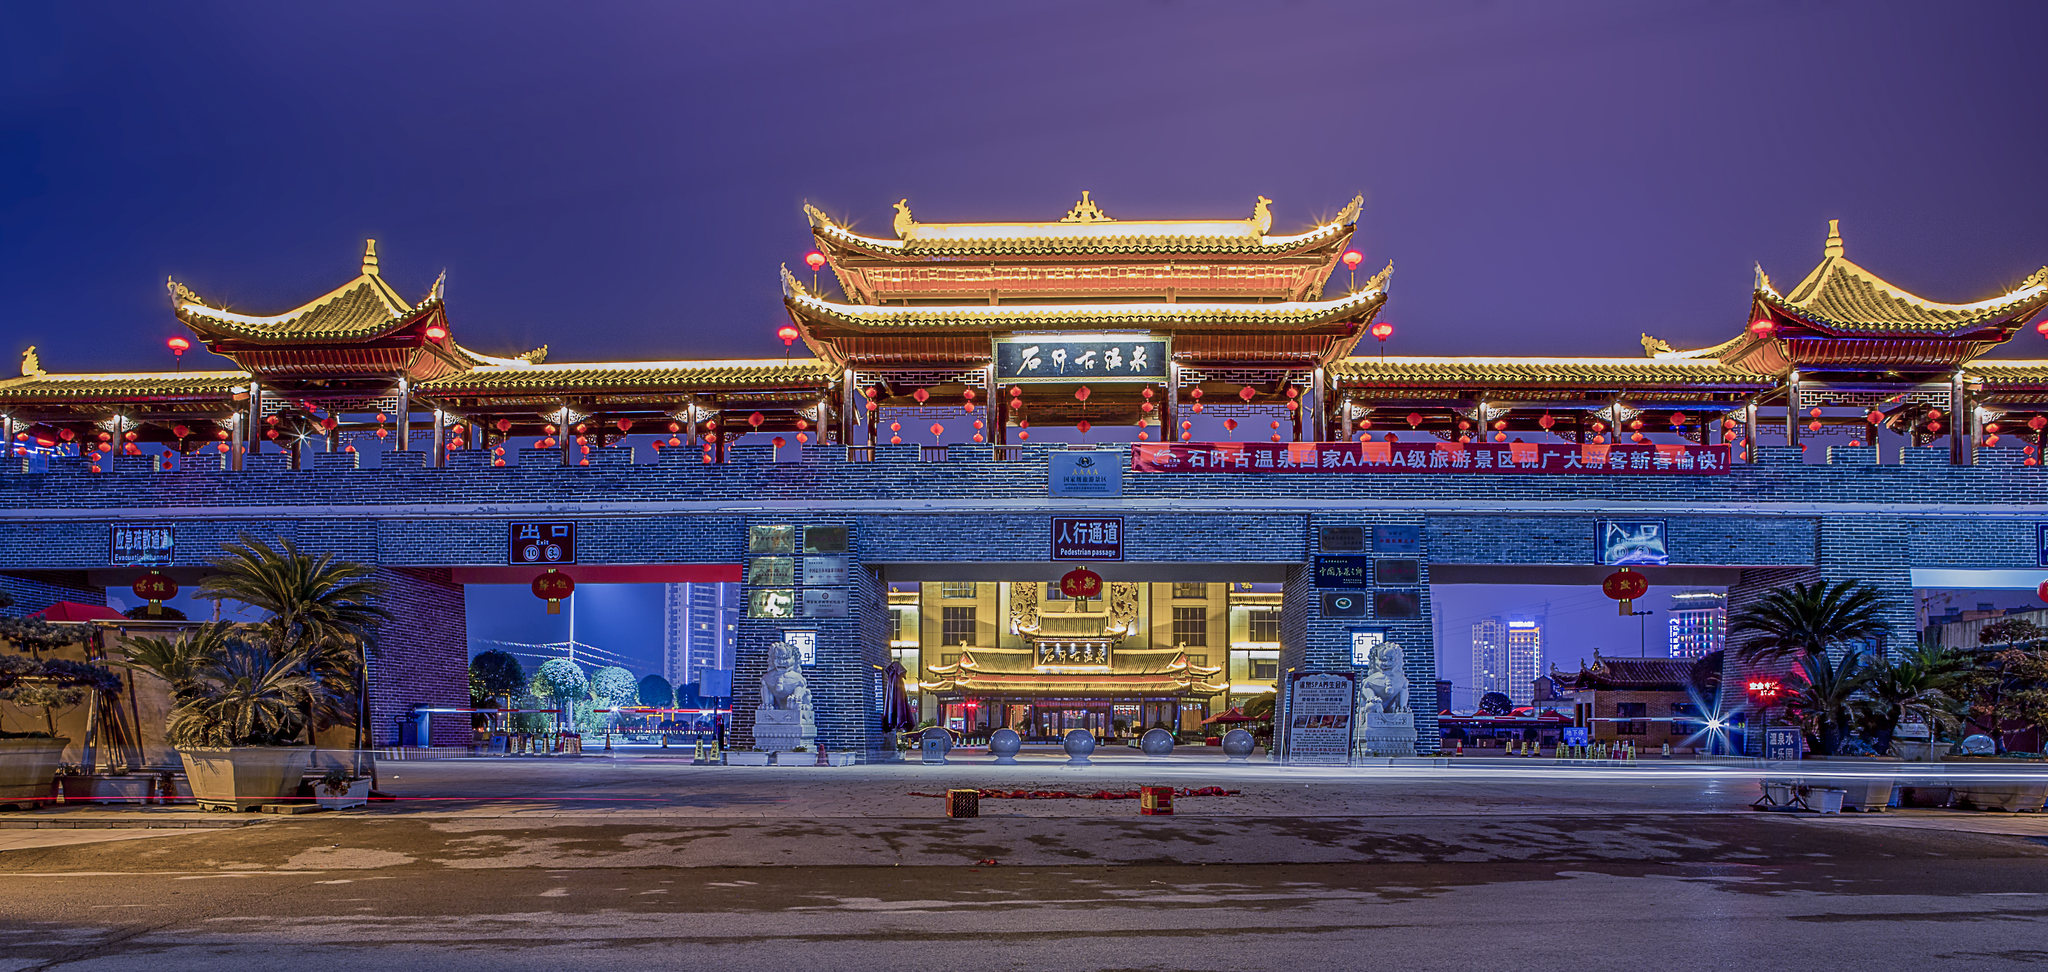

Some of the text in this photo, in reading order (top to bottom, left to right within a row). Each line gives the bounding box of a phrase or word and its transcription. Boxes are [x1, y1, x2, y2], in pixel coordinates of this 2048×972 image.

[520, 524, 568, 539] 出口
[1058, 522, 1118, 544] 人行通道
[1608, 523, 1659, 539] 入口
[115, 529, 169, 549] 应急疏散通道
[527, 549, 537, 557] 10
[1060, 548, 1091, 556] Pedestrian
[1770, 733, 1794, 745] 温泉水
[1770, 747, 1794, 760] 上乐园
